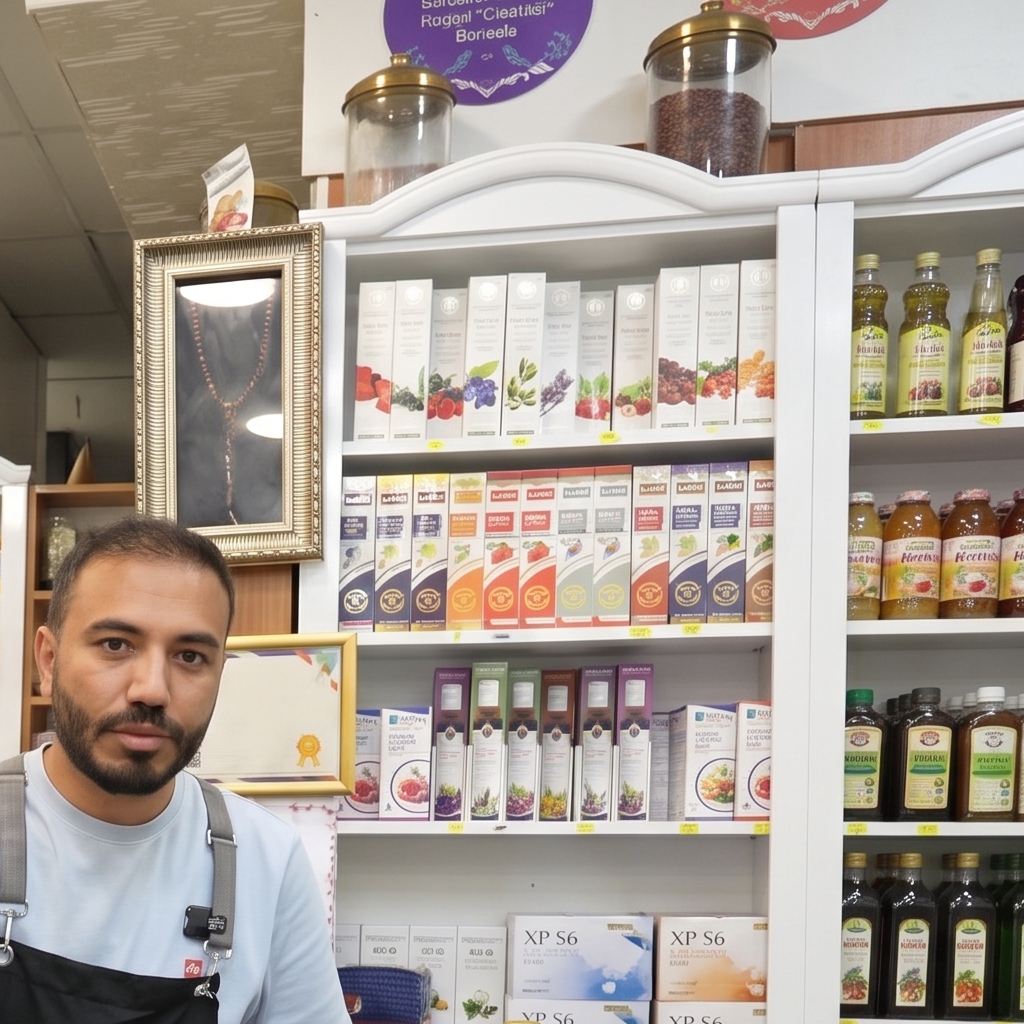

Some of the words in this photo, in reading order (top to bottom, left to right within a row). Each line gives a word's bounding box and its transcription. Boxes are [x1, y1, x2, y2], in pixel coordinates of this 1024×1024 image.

[524, 930, 550, 946] XP
[556, 930, 578, 946] S6
[670, 930, 697, 946] XP
[703, 930, 725, 946] S6
